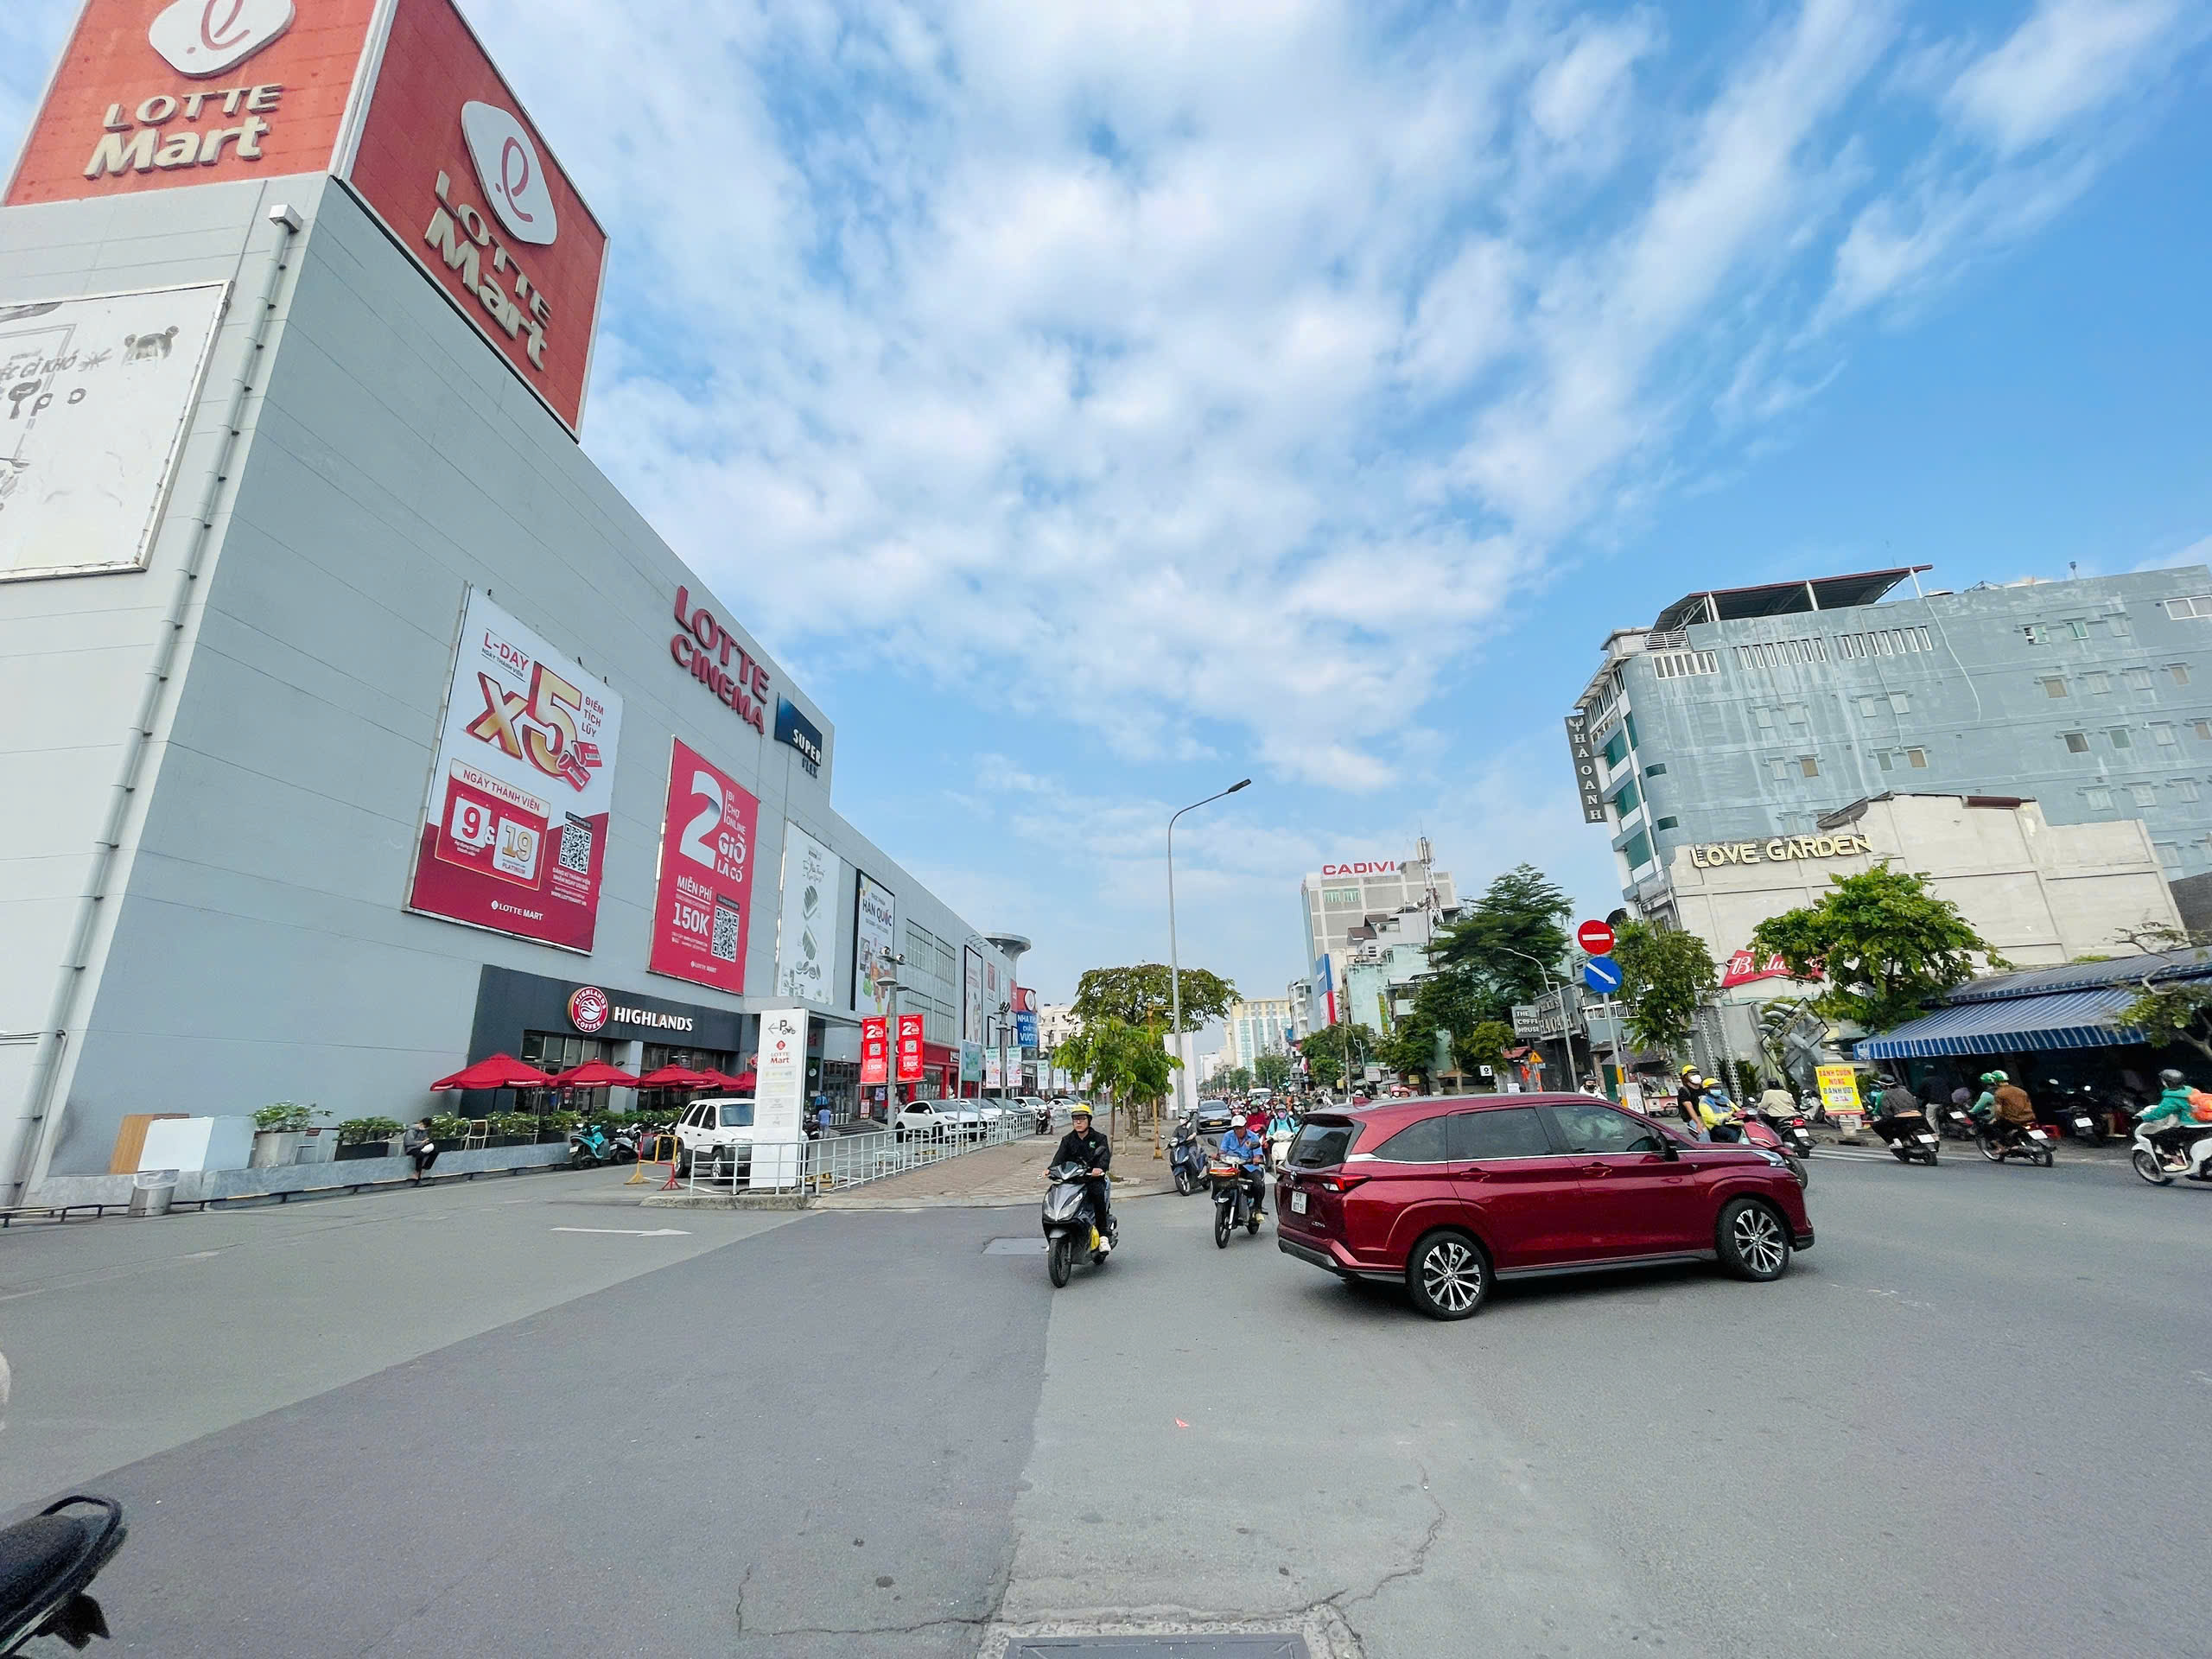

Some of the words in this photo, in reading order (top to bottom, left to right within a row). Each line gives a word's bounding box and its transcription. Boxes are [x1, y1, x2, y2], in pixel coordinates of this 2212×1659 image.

[103, 83, 284, 132] LOTTE
[83, 116, 270, 180] Mart
[435, 169, 552, 329] LOTTE
[424, 207, 548, 372] Mart
[483, 632, 530, 671] L-DAY
[673, 585, 771, 705] LOTTE
[671, 633, 765, 735] CINEMA
[583, 709, 601, 728] TÍCH
[792, 728, 822, 766] SUPER
[463, 769, 490, 788] NGÀY
[492, 782, 521, 802] THÀNH
[522, 795, 540, 812] VIÊN
[461, 806, 481, 840] 9
[484, 825, 495, 846] &
[502, 824, 533, 862] 19
[679, 770, 723, 869] 2
[726, 817, 747, 836] ONLINE
[1322, 861, 1395, 875] CADIVI
[1690, 843, 1760, 868] LOVE
[1765, 834, 1873, 861] GARDEN
[677, 874, 698, 894] MIỄN
[699, 884, 713, 901] PHÍ
[717, 857, 729, 877] LÀ
[729, 866, 744, 883] CÓ
[499, 903, 523, 916] LOTTE
[523, 909, 543, 921] MART
[672, 901, 710, 937] 150K
[575, 988, 607, 1010] HIGHLANDS
[576, 1018, 601, 1031] COFFEE
[613, 1006, 693, 1032] HIGHLANDS
[867, 1025, 876, 1039] 2
[902, 1021, 912, 1036] 2
